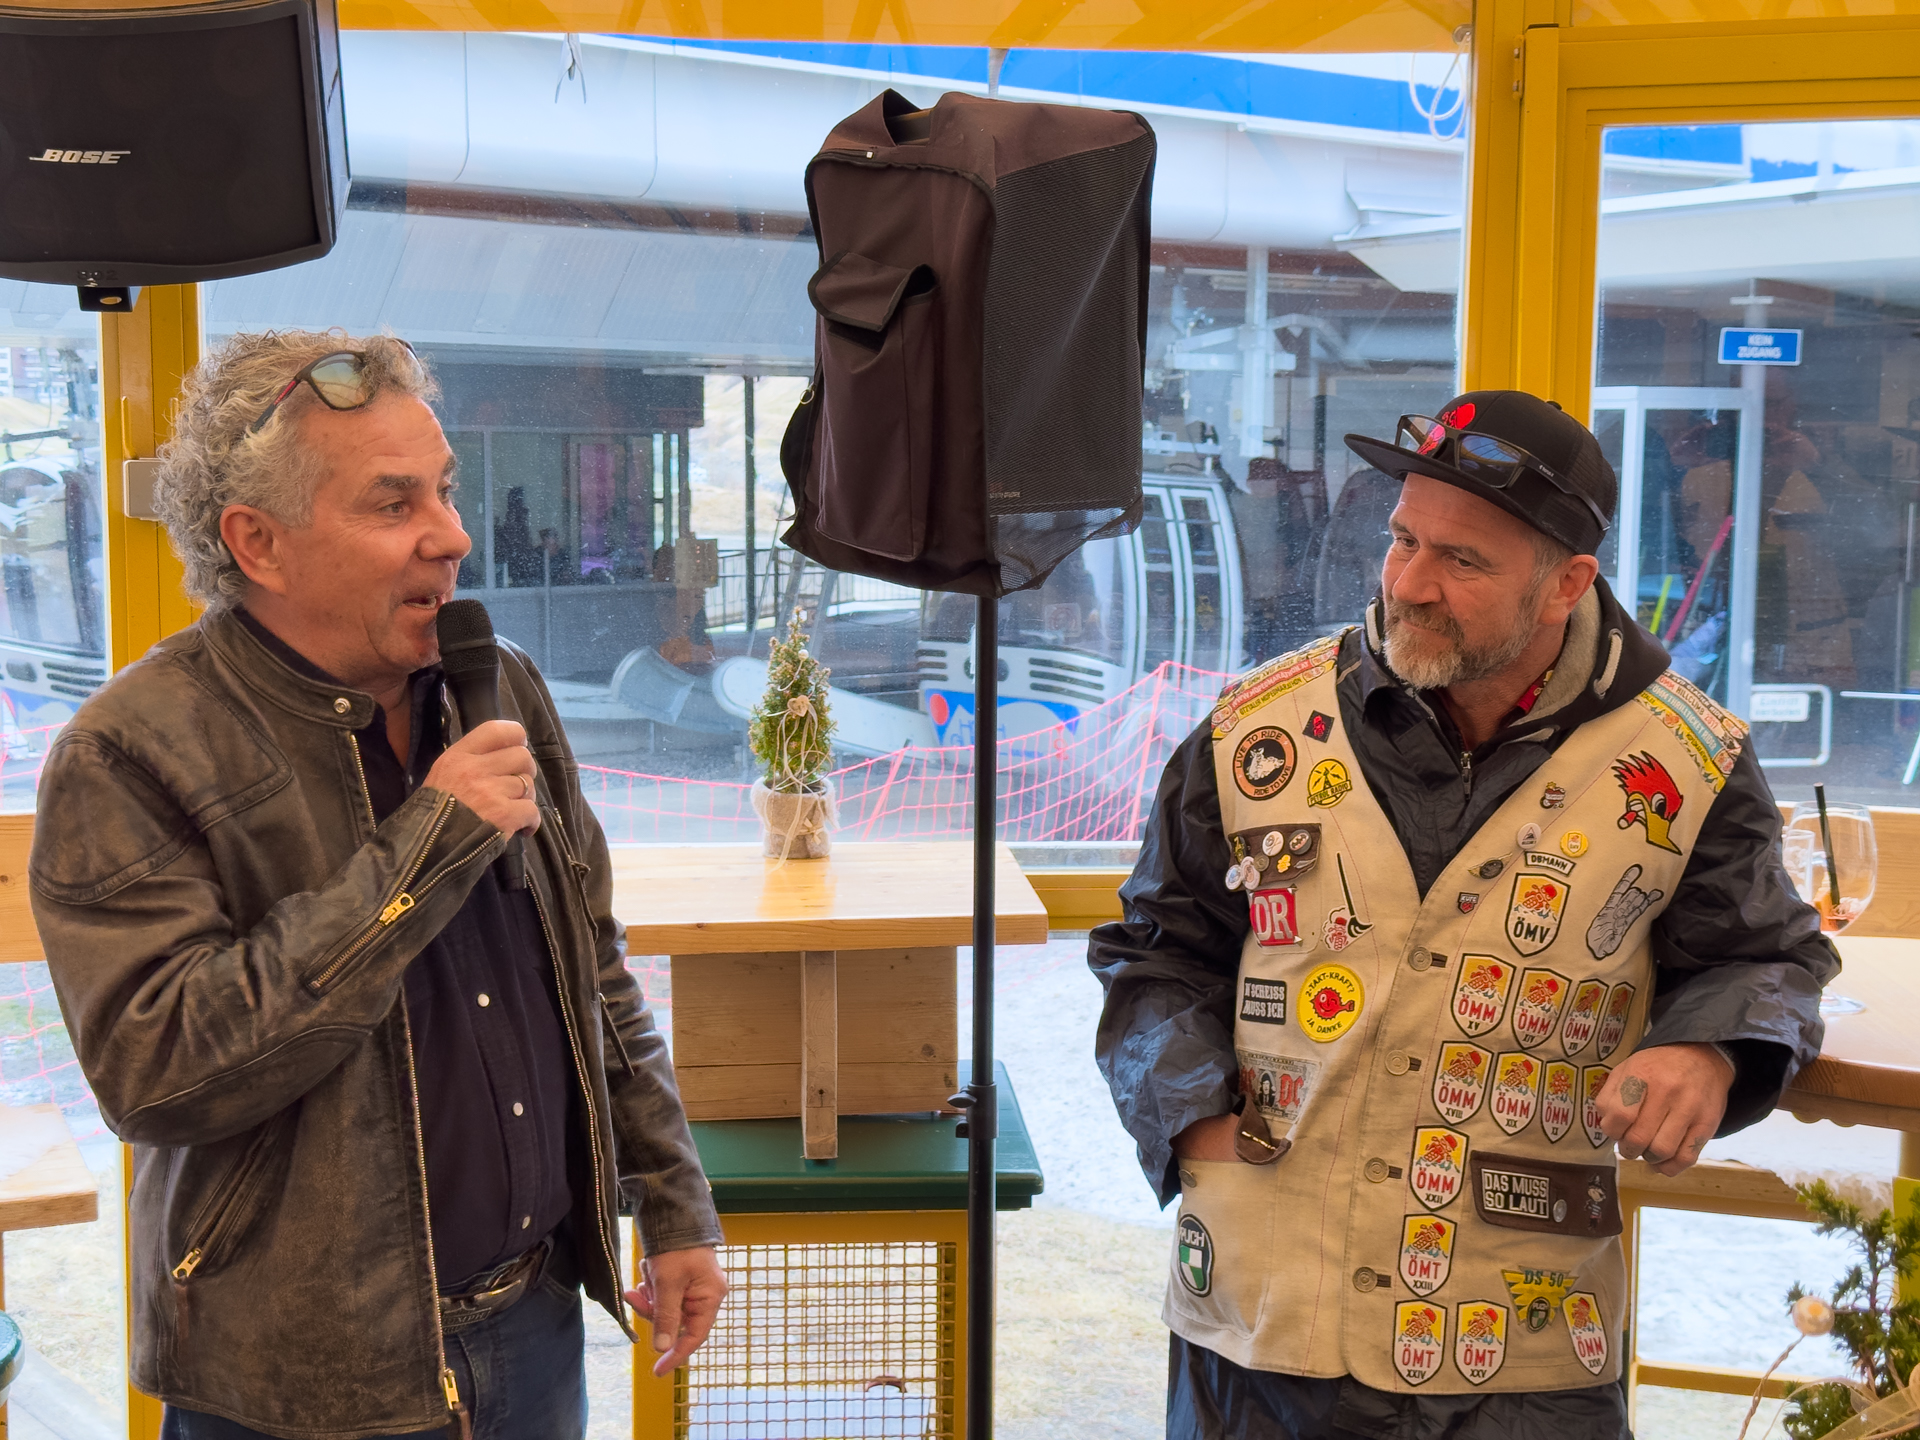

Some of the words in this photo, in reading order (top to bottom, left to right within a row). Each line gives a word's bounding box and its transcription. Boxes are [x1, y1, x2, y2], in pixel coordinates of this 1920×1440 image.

[29, 149, 131, 164] BOSE
[1747, 334, 1774, 346] KEIN
[1737, 346, 1782, 359] ZUGANG
[1675, 687, 1704, 716] HILLCLIMB
[1667, 694, 1703, 735] THRILLTICKET
[1700, 732, 1718, 752] RIDER
[1236, 745, 1248, 769] LIVE
[1246, 734, 1259, 745] TO
[1261, 730, 1283, 740] RIDE
[1253, 787, 1270, 796] RIDE
[1270, 780, 1281, 792] TO
[1280, 765, 1292, 783] LIVE
[1309, 789, 1331, 804] PETROL
[1331, 781, 1350, 795] RADIO
[1254, 894, 1294, 941] DR
[1513, 916, 1551, 944] ÖMV
[1250, 984, 1285, 1001] SCHEISS
[1305, 971, 1355, 997] 2-TAKT-KRAFT?
[1242, 1000, 1267, 1017] MUSS
[1267, 1002, 1284, 1018] ICH
[1458, 993, 1497, 1023] ÖMM
[1306, 1017, 1314, 1028] JA
[1316, 1021, 1343, 1034] DANKE
[1467, 1020, 1480, 1031] XV
[1517, 1008, 1552, 1036] ÖMM
[1565, 1017, 1591, 1041] ÖMM
[1600, 1023, 1621, 1044] ÖMM
[1438, 1081, 1477, 1110] ÖMM
[1496, 1092, 1531, 1119] ÖMM
[1444, 1107, 1464, 1119] XVIII
[1505, 1118, 1518, 1128] XIX
[1545, 1101, 1570, 1126] ÖMM
[1586, 1106, 1602, 1129] ÖM
[1416, 1167, 1455, 1195] ÖMM
[1484, 1172, 1510, 1192] DAS
[1511, 1177, 1548, 1198] MUSS
[1425, 1193, 1443, 1205] XXII
[1484, 1191, 1505, 1209] SO
[1509, 1194, 1547, 1215] LAUT
[1180, 1226, 1205, 1248] PUCH
[1408, 1254, 1442, 1280] ÖMT
[1523, 1269, 1543, 1286] DS
[1548, 1272, 1565, 1288] 50
[1412, 1279, 1434, 1291] XXIII
[1402, 1343, 1435, 1368] ÖMT
[1463, 1343, 1497, 1368] ÖMT
[1576, 1335, 1605, 1358] ÖMM
[1406, 1369, 1427, 1380] XXIV
[1469, 1368, 1487, 1378] XXV
